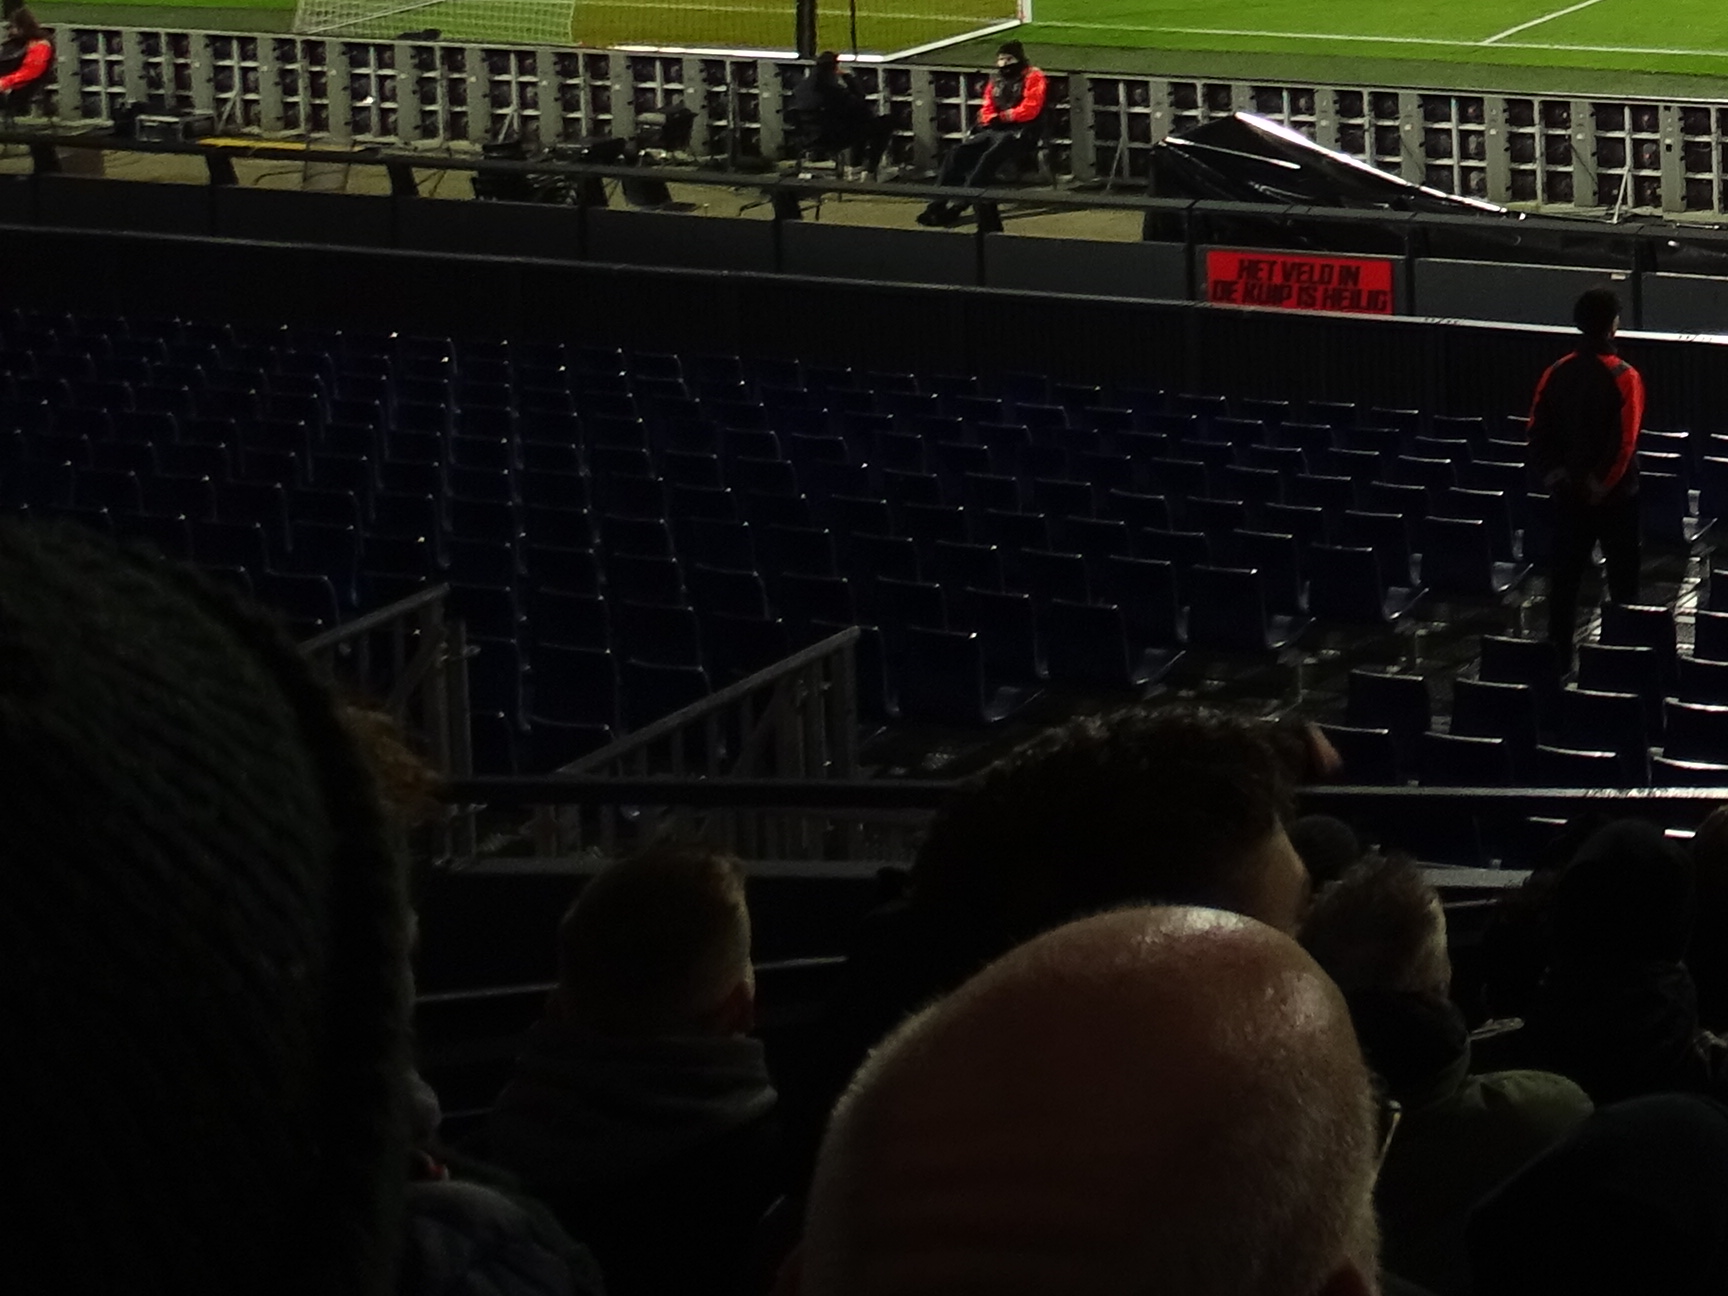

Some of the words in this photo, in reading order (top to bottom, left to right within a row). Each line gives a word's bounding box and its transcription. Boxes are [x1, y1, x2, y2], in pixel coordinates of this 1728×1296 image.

[1239, 260, 1277, 281] HET
[1282, 262, 1334, 286] VELD
[1339, 265, 1361, 287] IN
[1211, 280, 1240, 303] DE
[1242, 282, 1292, 307] KUIP
[1296, 285, 1320, 309] IS
[1322, 287, 1390, 313] HEILIG
